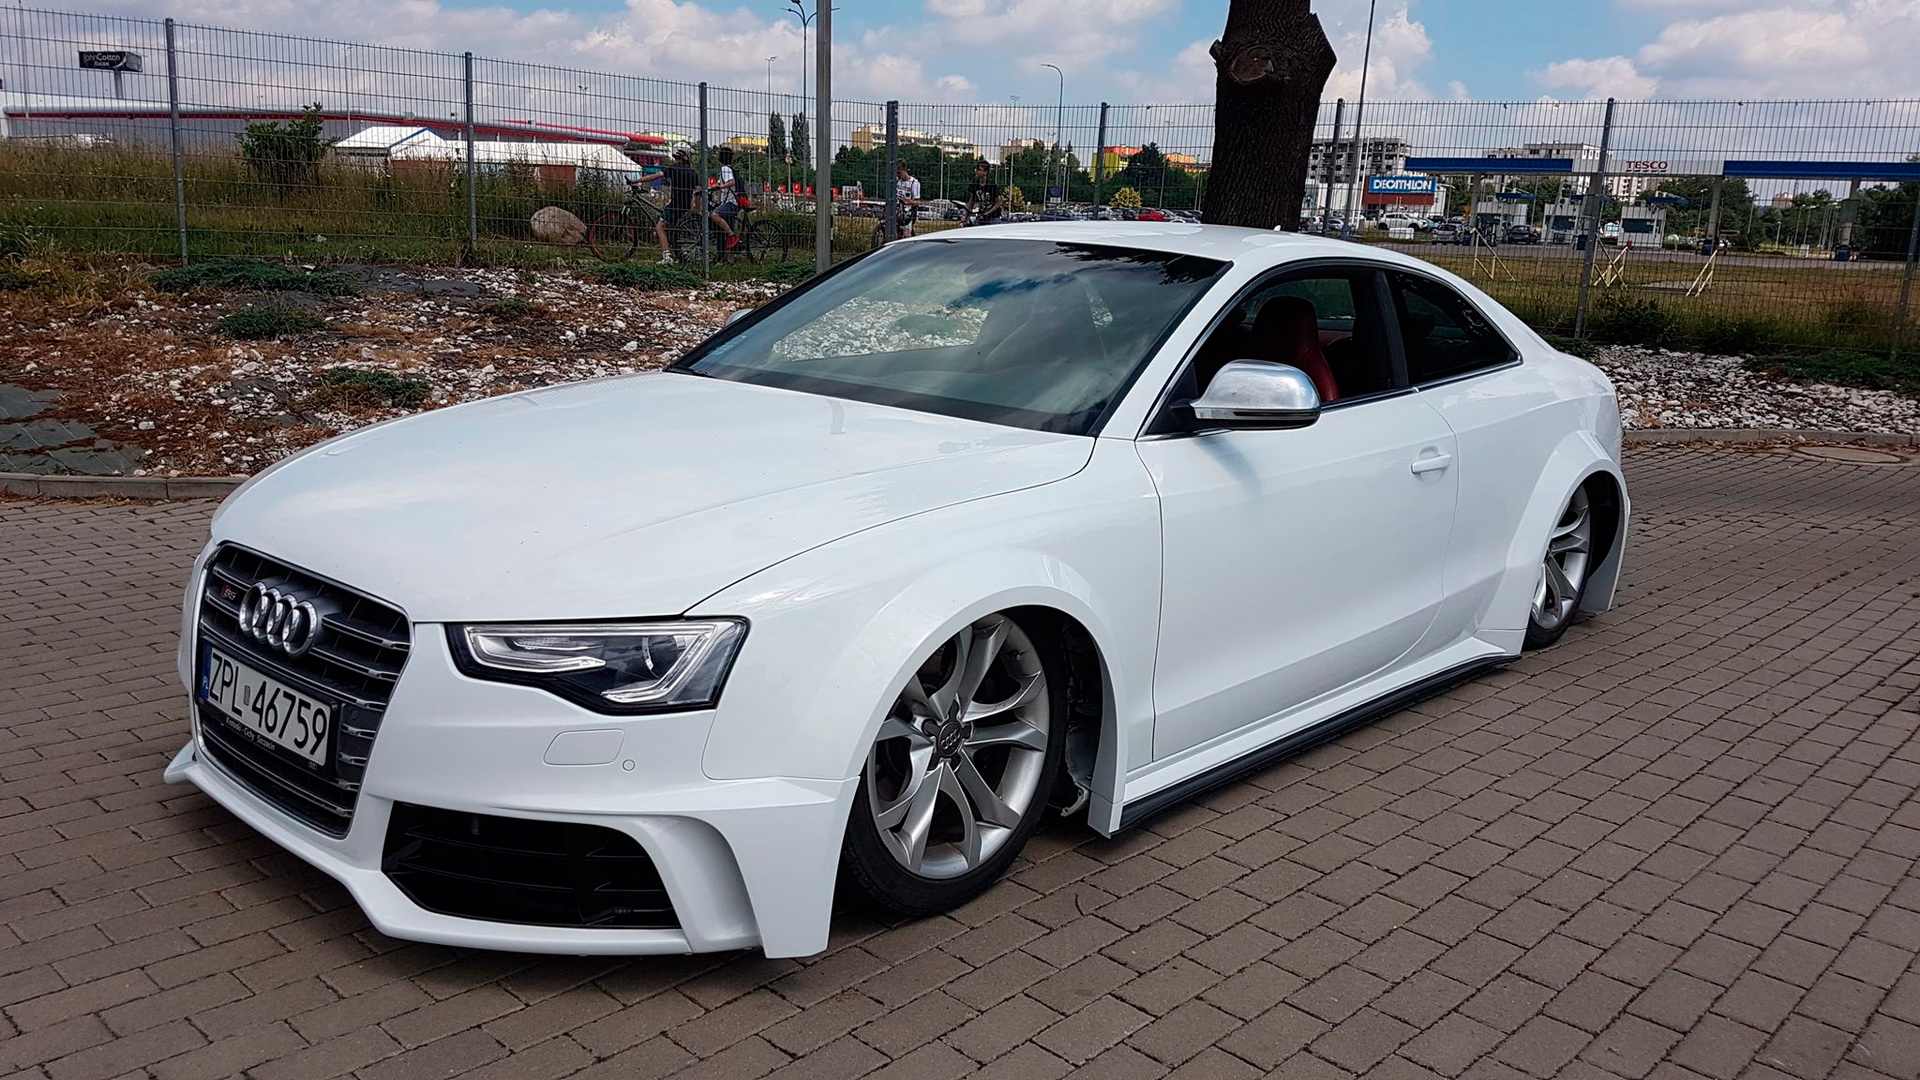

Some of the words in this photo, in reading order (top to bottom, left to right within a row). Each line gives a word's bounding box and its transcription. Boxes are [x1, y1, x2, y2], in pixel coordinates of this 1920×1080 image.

[1626, 161, 1668, 170] TESCO
[1373, 179, 1432, 190] DECATHLON
[209, 652, 243, 717] ZPL
[252, 680, 328, 756] 46759
